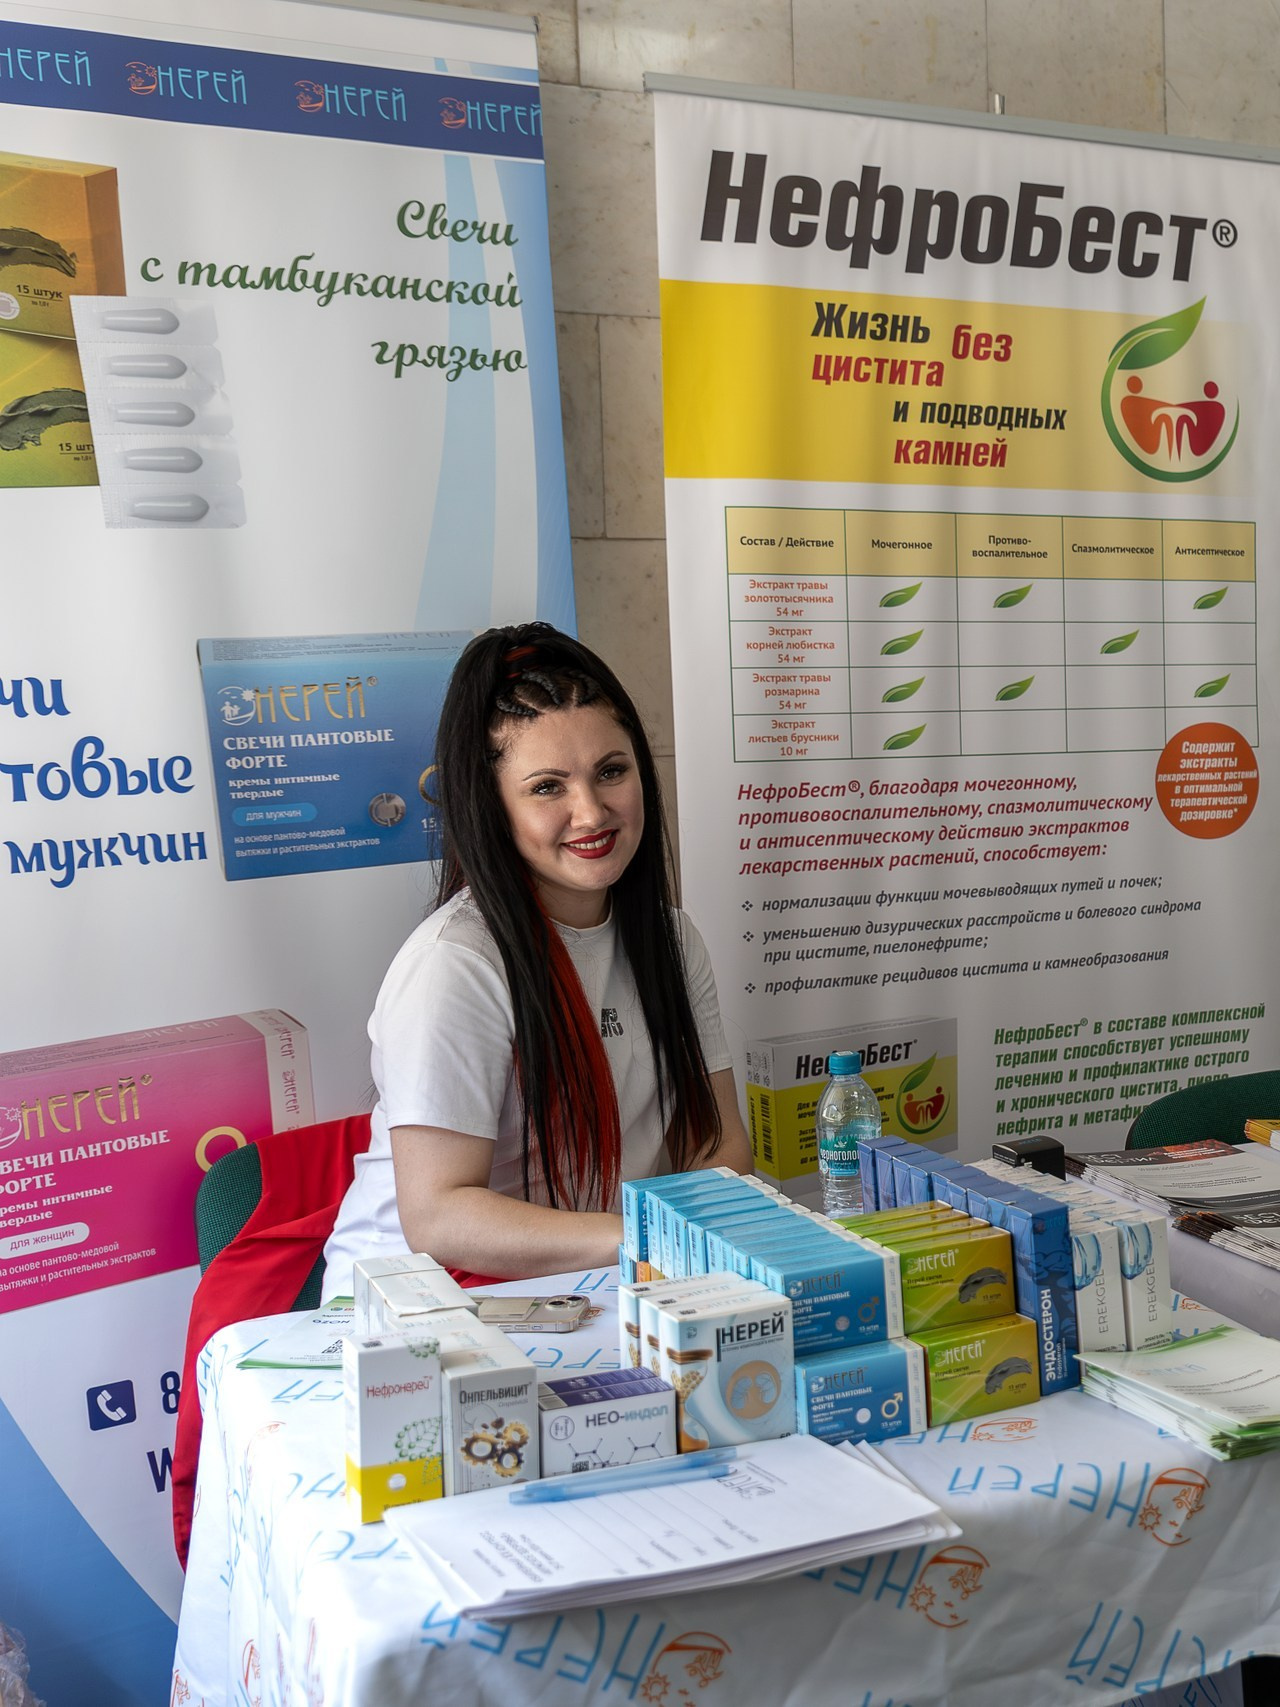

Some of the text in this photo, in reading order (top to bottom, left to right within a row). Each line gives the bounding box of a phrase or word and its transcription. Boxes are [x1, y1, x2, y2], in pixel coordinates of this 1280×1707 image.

[0, 47, 91, 87] НЕРЕЙ
[157, 65, 247, 104] НЕРЕЙ
[325, 83, 407, 122] НЕРЕЙ
[467, 101, 543, 136] НЕРЕЙ
[397, 200, 519, 246] Свечи
[700, 149, 1239, 283] НефроБест®
[16, 284, 63, 299] 15 штук
[141, 253, 523, 308] с тамбуканской
[811, 301, 1013, 363] Жизнь без
[371, 341, 527, 381] грязью
[811, 354, 946, 389] цистита
[892, 400, 1068, 432] и подводных
[893, 436, 1008, 470] камней
[740, 536, 835, 548] Состав Действие
[871, 539, 933, 550] Мочегонное
[988, 535, 1032, 546] Противо-
[1071, 544, 1155, 555] Спазмолитическое
[1175, 546, 1245, 558] Антисептическое
[972, 548, 1048, 560] воспалительное
[749, 580, 828, 591] Экстракт травы
[744, 594, 834, 604] золототысячника
[776, 608, 804, 617] 54 мг
[768, 627, 813, 637] Экстракт
[746, 640, 835, 650] корней любистка
[752, 674, 831, 684] Экстракт травы
[765, 687, 820, 697] розмарина
[771, 720, 816, 730] Экстракт
[223, 729, 395, 751] СВЕЧИ ПАНТОВЫЕ
[748, 733, 839, 745] листьев брусники
[1181, 741, 1235, 754] Содержит
[226, 754, 287, 771] ФОРТЕ
[780, 747, 808, 757] 10 мг
[1180, 755, 1238, 769] экстракты
[0, 735, 195, 802] товые
[229, 771, 340, 788] кремы интимные
[230, 788, 284, 800] твердые
[869, 777, 959, 798] благодаря
[963, 774, 1078, 793] мочегонному,
[246, 808, 301, 822] для мужчин
[738, 794, 1153, 827] противовоспалительному, спазмолитическому
[234, 826, 345, 843] на основе пантово-медовой
[740, 817, 1130, 850] и антисептическому действию экстрактов
[3, 831, 208, 888] мужчин
[739, 842, 1108, 876] лекарственных растений, способствует:
[761, 874, 1163, 912] нормализации функции мочевыводящих путей и почек;
[994, 1003, 1265, 1046] НефроБест® в составе комплексной
[995, 1029, 1250, 1069] терапии способствует успешному
[59, 1129, 171, 1164] ПАНТОВЫЕ
[42, 1183, 113, 1207] интимные
[10, 1228, 75, 1252] для женщин
[9, 1242, 120, 1274] основе пантово-медовой
[1095, 1269, 1108, 1333] EREKGEL
[1147, 1259, 1157, 1322] EREKGEL
[1041, 1289, 1056, 1381] ЭНДОСТЕРОН
[948, 1462, 1152, 1528] НЕРЕЙ
[420, 1608, 666, 1700] НЕРЕЙ
